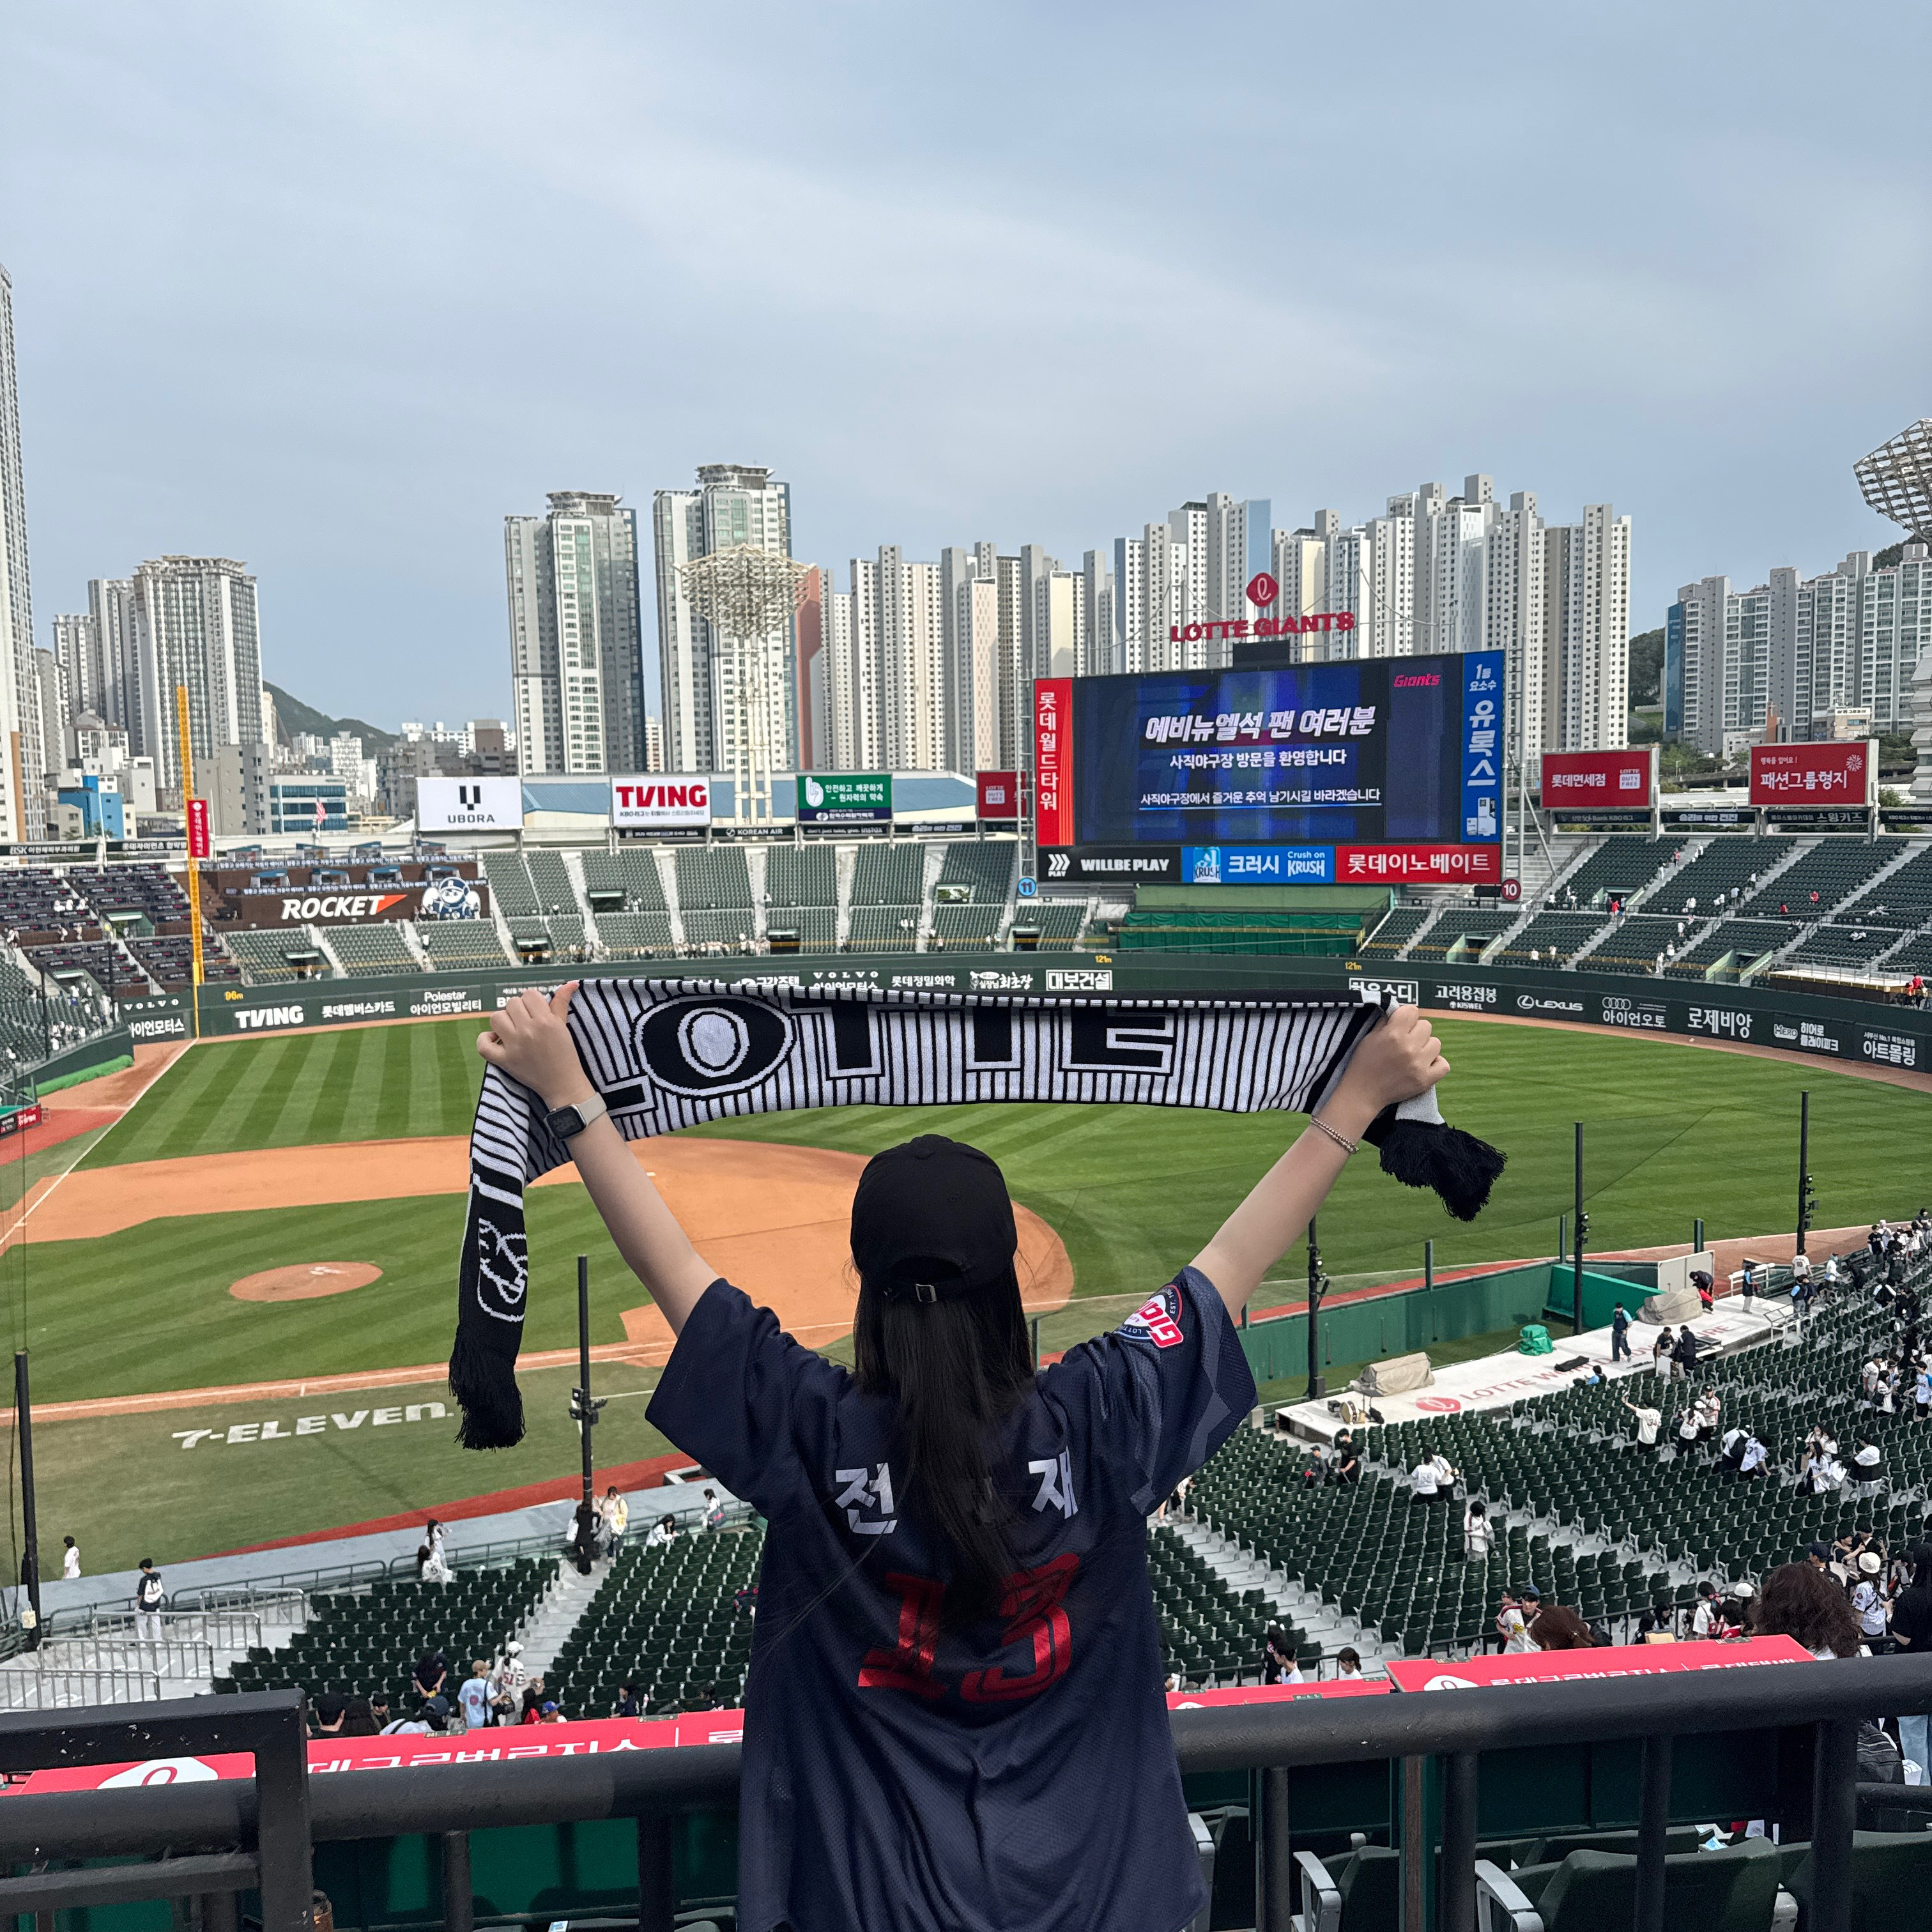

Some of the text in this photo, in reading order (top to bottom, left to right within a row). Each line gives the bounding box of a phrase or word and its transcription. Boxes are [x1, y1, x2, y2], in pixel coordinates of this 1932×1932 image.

[1170, 611, 1354, 642] LOTTE GIANTS
[1393, 673, 1442, 687] Giants
[1469, 680, 1497, 692] 요소수
[1145, 706, 1376, 743] 에비뉴엘석 팬 여러분
[1039, 692, 1059, 811] 롯데월드타워
[1467, 700, 1497, 786] 유록스
[1170, 749, 1347, 769] 사직야구장 방문을 환영합니다
[1551, 773, 1606, 788] 롯데면세점
[1760, 770, 1848, 790] 패션그룹형지
[615, 785, 707, 808] TVING
[1140, 788, 1381, 805] 사직야구장에서 즐거운 추억 남기시길 바라겠습니다
[448, 814, 495, 824] UBORA
[1816, 812, 1864, 822] 스윙키즈
[1287, 851, 1312, 859] Crush
[1228, 854, 1279, 875] 크러시
[1287, 859, 1326, 877] KRUSH
[1347, 853, 1491, 875] 롯데이노베이트
[1193, 866, 1221, 880] KRUSH
[1021, 882, 1032, 893] 11
[1504, 884, 1517, 896] 10
[280, 894, 385, 920] ROCKET
[1094, 955, 1112, 963] 121m
[1345, 962, 1362, 971] 121m
[813, 970, 878, 979] VOLVO
[891, 975, 956, 988] 롯데정밀화학
[1048, 971, 1110, 990] 대보건설
[224, 990, 243, 1000] 96m
[424, 990, 467, 1002] Polestar
[1435, 985, 1497, 1004] 고려용접봉
[123, 999, 180, 1011] VOLVO
[322, 1000, 395, 1018] 롯데멤버스카드
[410, 999, 482, 1016] 아이언모빌리티
[1457, 1001, 1483, 1011] KISWEL
[1535, 999, 1584, 1011] LEXUS
[234, 1005, 304, 1029] TVING
[1602, 1009, 1667, 1029] 아이언오토
[1687, 1006, 1752, 1039] 로제비앙
[1774, 1024, 1798, 1038] HERO
[1800, 1022, 1825, 1037] 히어로
[1863, 1039, 1915, 1067] 아트몰링
[1459, 1377, 1534, 1400] LOTTE
[857, 1552, 1081, 1703] 13
